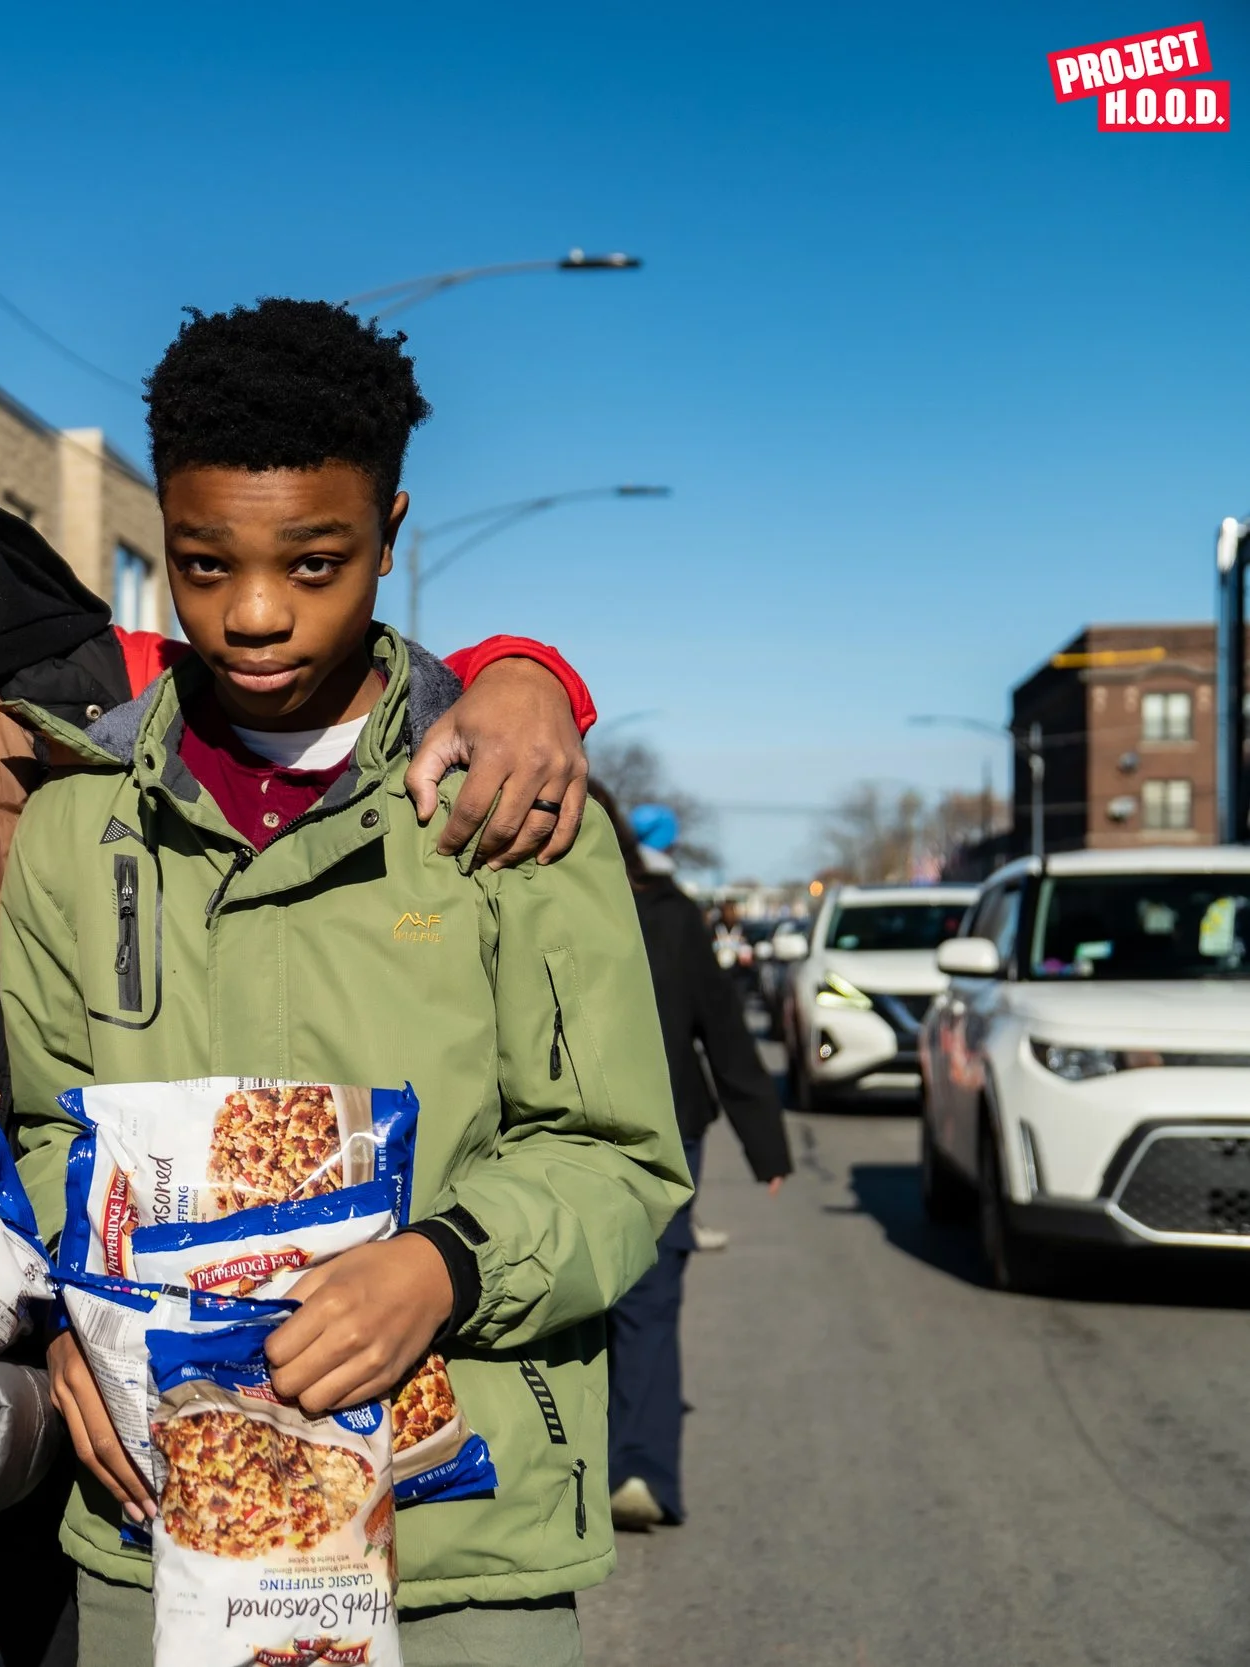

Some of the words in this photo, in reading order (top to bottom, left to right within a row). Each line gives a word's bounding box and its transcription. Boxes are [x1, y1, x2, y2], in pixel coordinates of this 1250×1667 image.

[110, 1172, 127, 1200] FARM
[148, 1154, 174, 1225] asoned
[178, 1185, 189, 1223] FFING
[107, 1202, 123, 1274] PEPPERIDGE
[197, 1259, 269, 1289] PEPPERIDGE
[270, 1255, 300, 1269] FARM
[347, 1410, 372, 1421] PREP
[352, 1416, 376, 1428] EASY
[259, 1578, 325, 1591] STUFFING
[328, 1573, 373, 1588] CLASSIC
[226, 1594, 338, 1628] Seasoned
[342, 1588, 392, 1625] Herb
